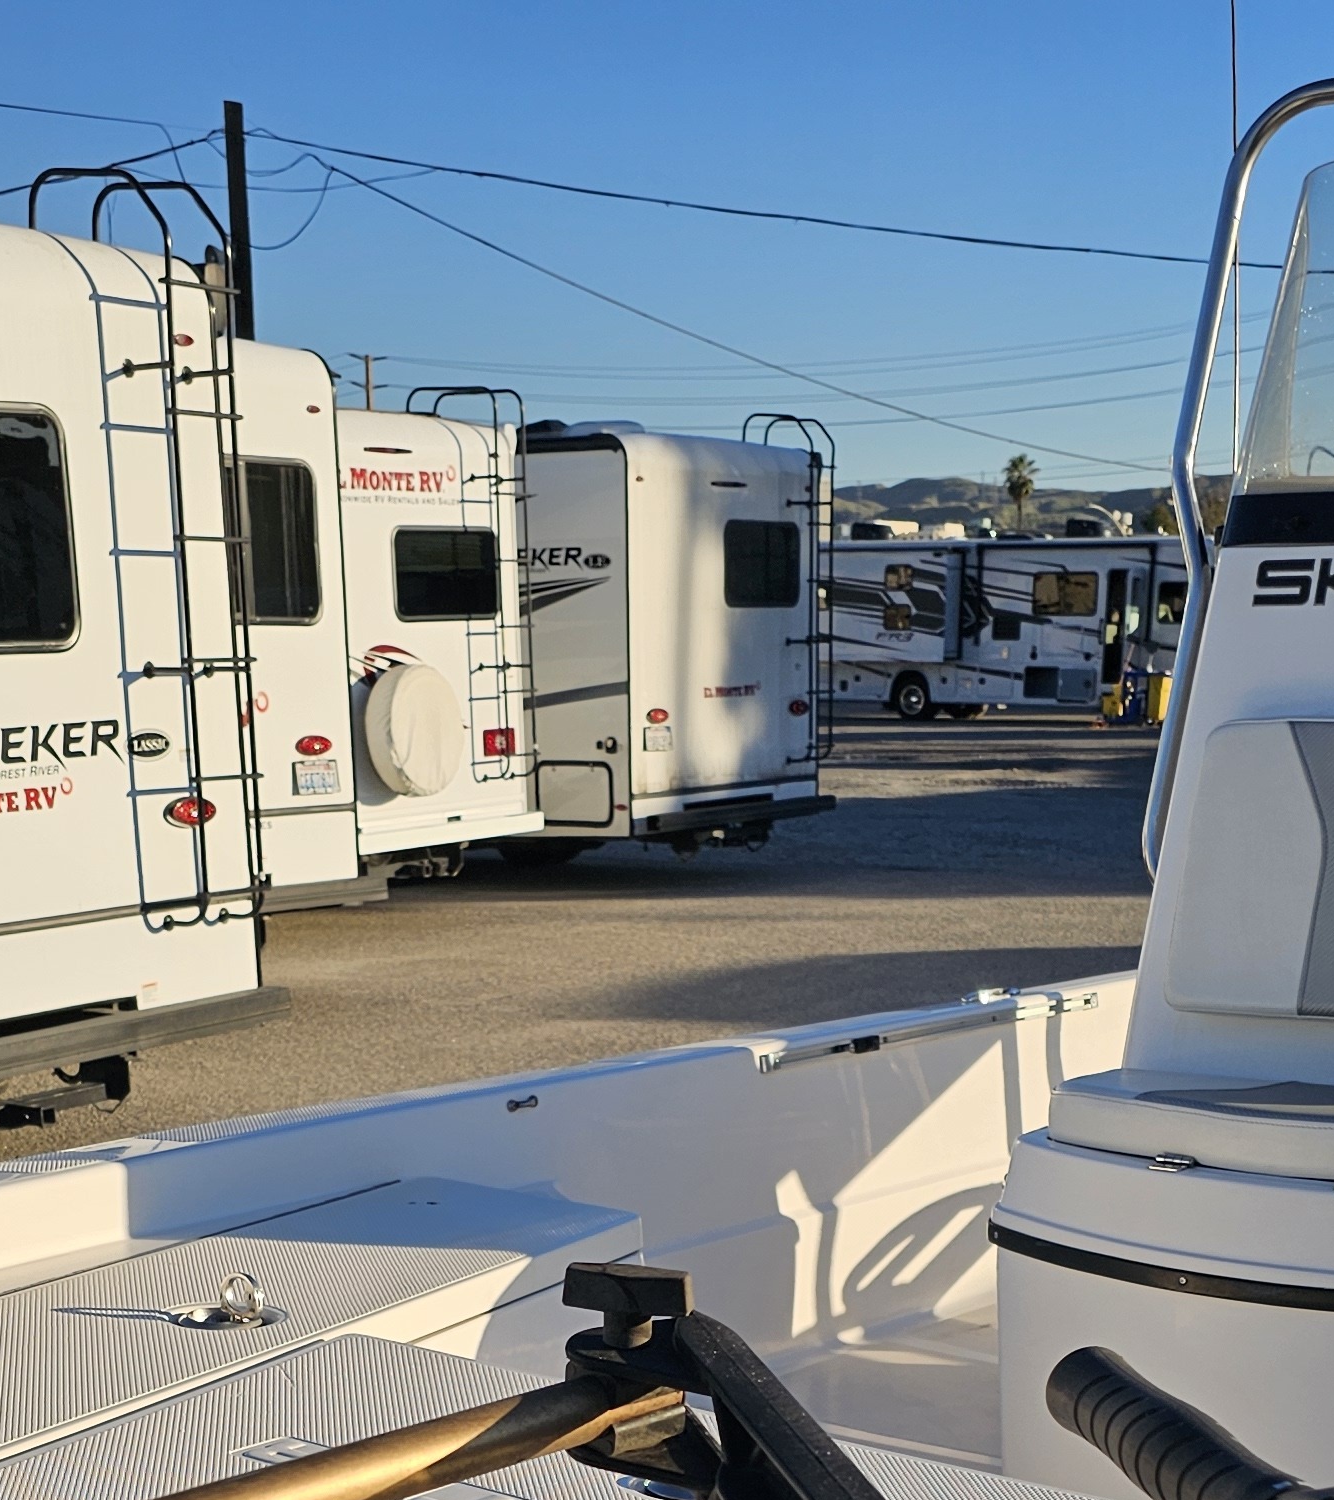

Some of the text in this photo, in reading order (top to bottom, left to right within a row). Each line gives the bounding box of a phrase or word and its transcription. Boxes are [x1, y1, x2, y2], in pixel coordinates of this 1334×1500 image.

[350, 467, 415, 492] MONTE
[419, 471, 443, 492] RV
[29, 765, 59, 777] RIVER
[24, 786, 57, 811] RV
